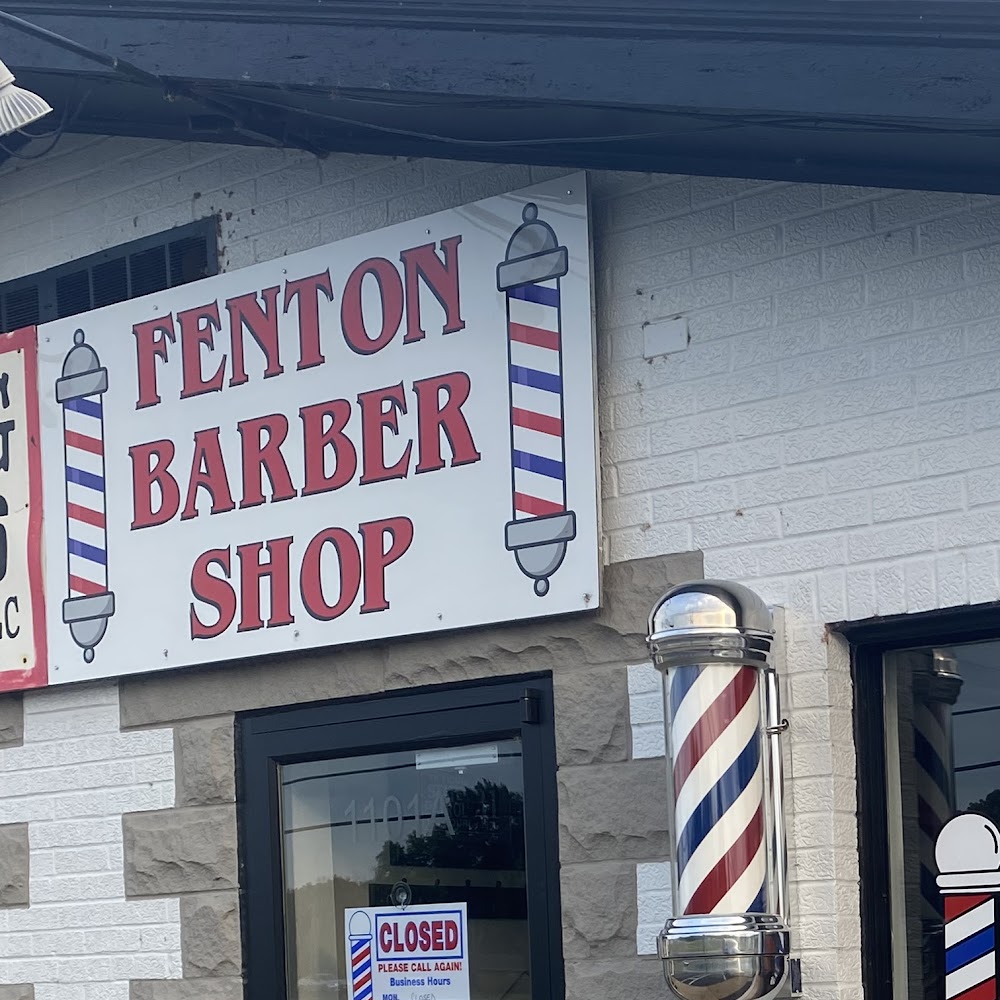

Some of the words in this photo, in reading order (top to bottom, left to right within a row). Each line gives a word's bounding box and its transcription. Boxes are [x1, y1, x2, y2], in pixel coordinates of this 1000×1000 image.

[132, 234, 466, 411] FENTON
[128, 371, 482, 531] BARBER
[189, 515, 415, 641] SHOP
[378, 963, 408, 973] PLEASE
[411, 962, 432, 972] CALL
[434, 962, 463, 972] AGAIN!
[379, 919, 459, 953] CLOSED
[390, 977, 425, 987] Business
[427, 977, 451, 986] Hours
